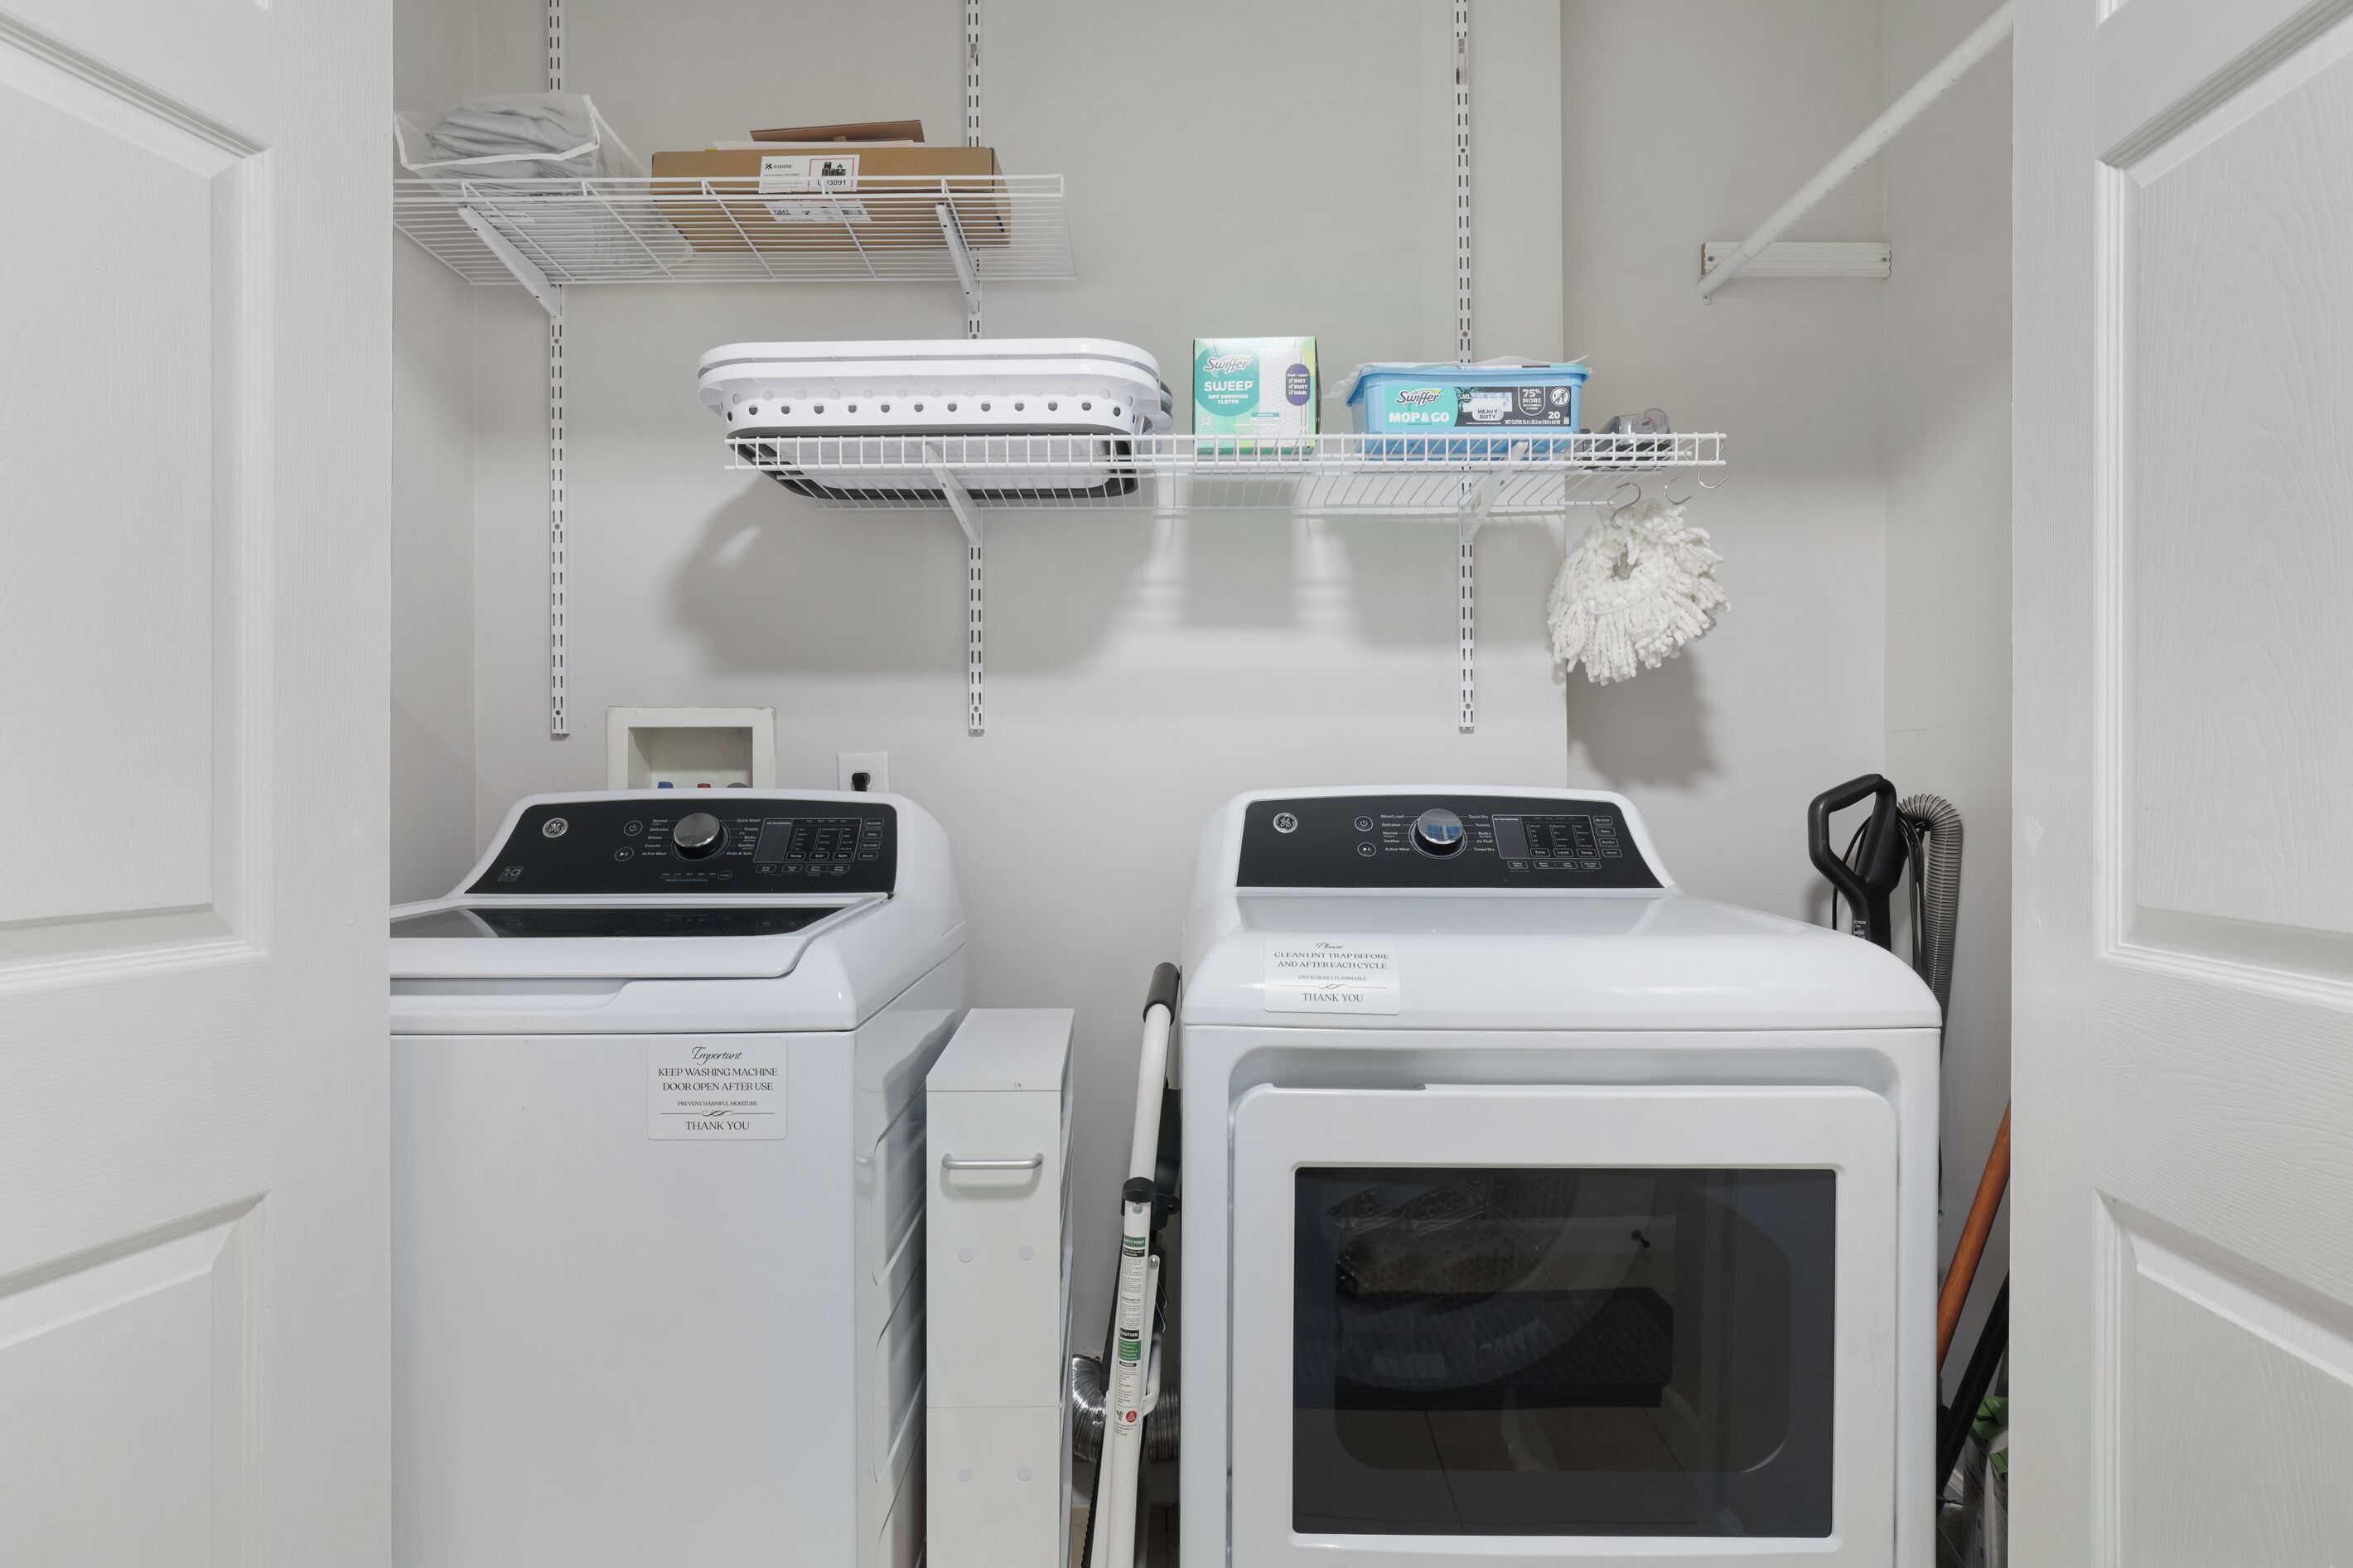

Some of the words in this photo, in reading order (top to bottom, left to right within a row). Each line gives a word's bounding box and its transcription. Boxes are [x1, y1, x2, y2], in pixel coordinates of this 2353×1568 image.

[1204, 357, 1249, 373] Swiffer
[1204, 380, 1254, 392] SWEEP
[1396, 390, 1440, 406] Swiffer
[1522, 388, 1541, 398] 75%
[1548, 411, 1561, 420] 20
[1199, 417, 1212, 426] 32
[1302, 992, 1339, 1001] THANK
[1341, 993, 1364, 1002] YOU
[691, 1046, 742, 1066] Important
[658, 1068, 684, 1077] KEEP
[684, 1068, 731, 1077] WASHING
[732, 1068, 778, 1077] MACHINE
[662, 1082, 692, 1091] DOOR
[693, 1082, 719, 1091] OPEN
[721, 1082, 753, 1091] AFTER
[755, 1082, 774, 1091] USE
[685, 1121, 724, 1130] THANK
[726, 1121, 750, 1130] YOU
